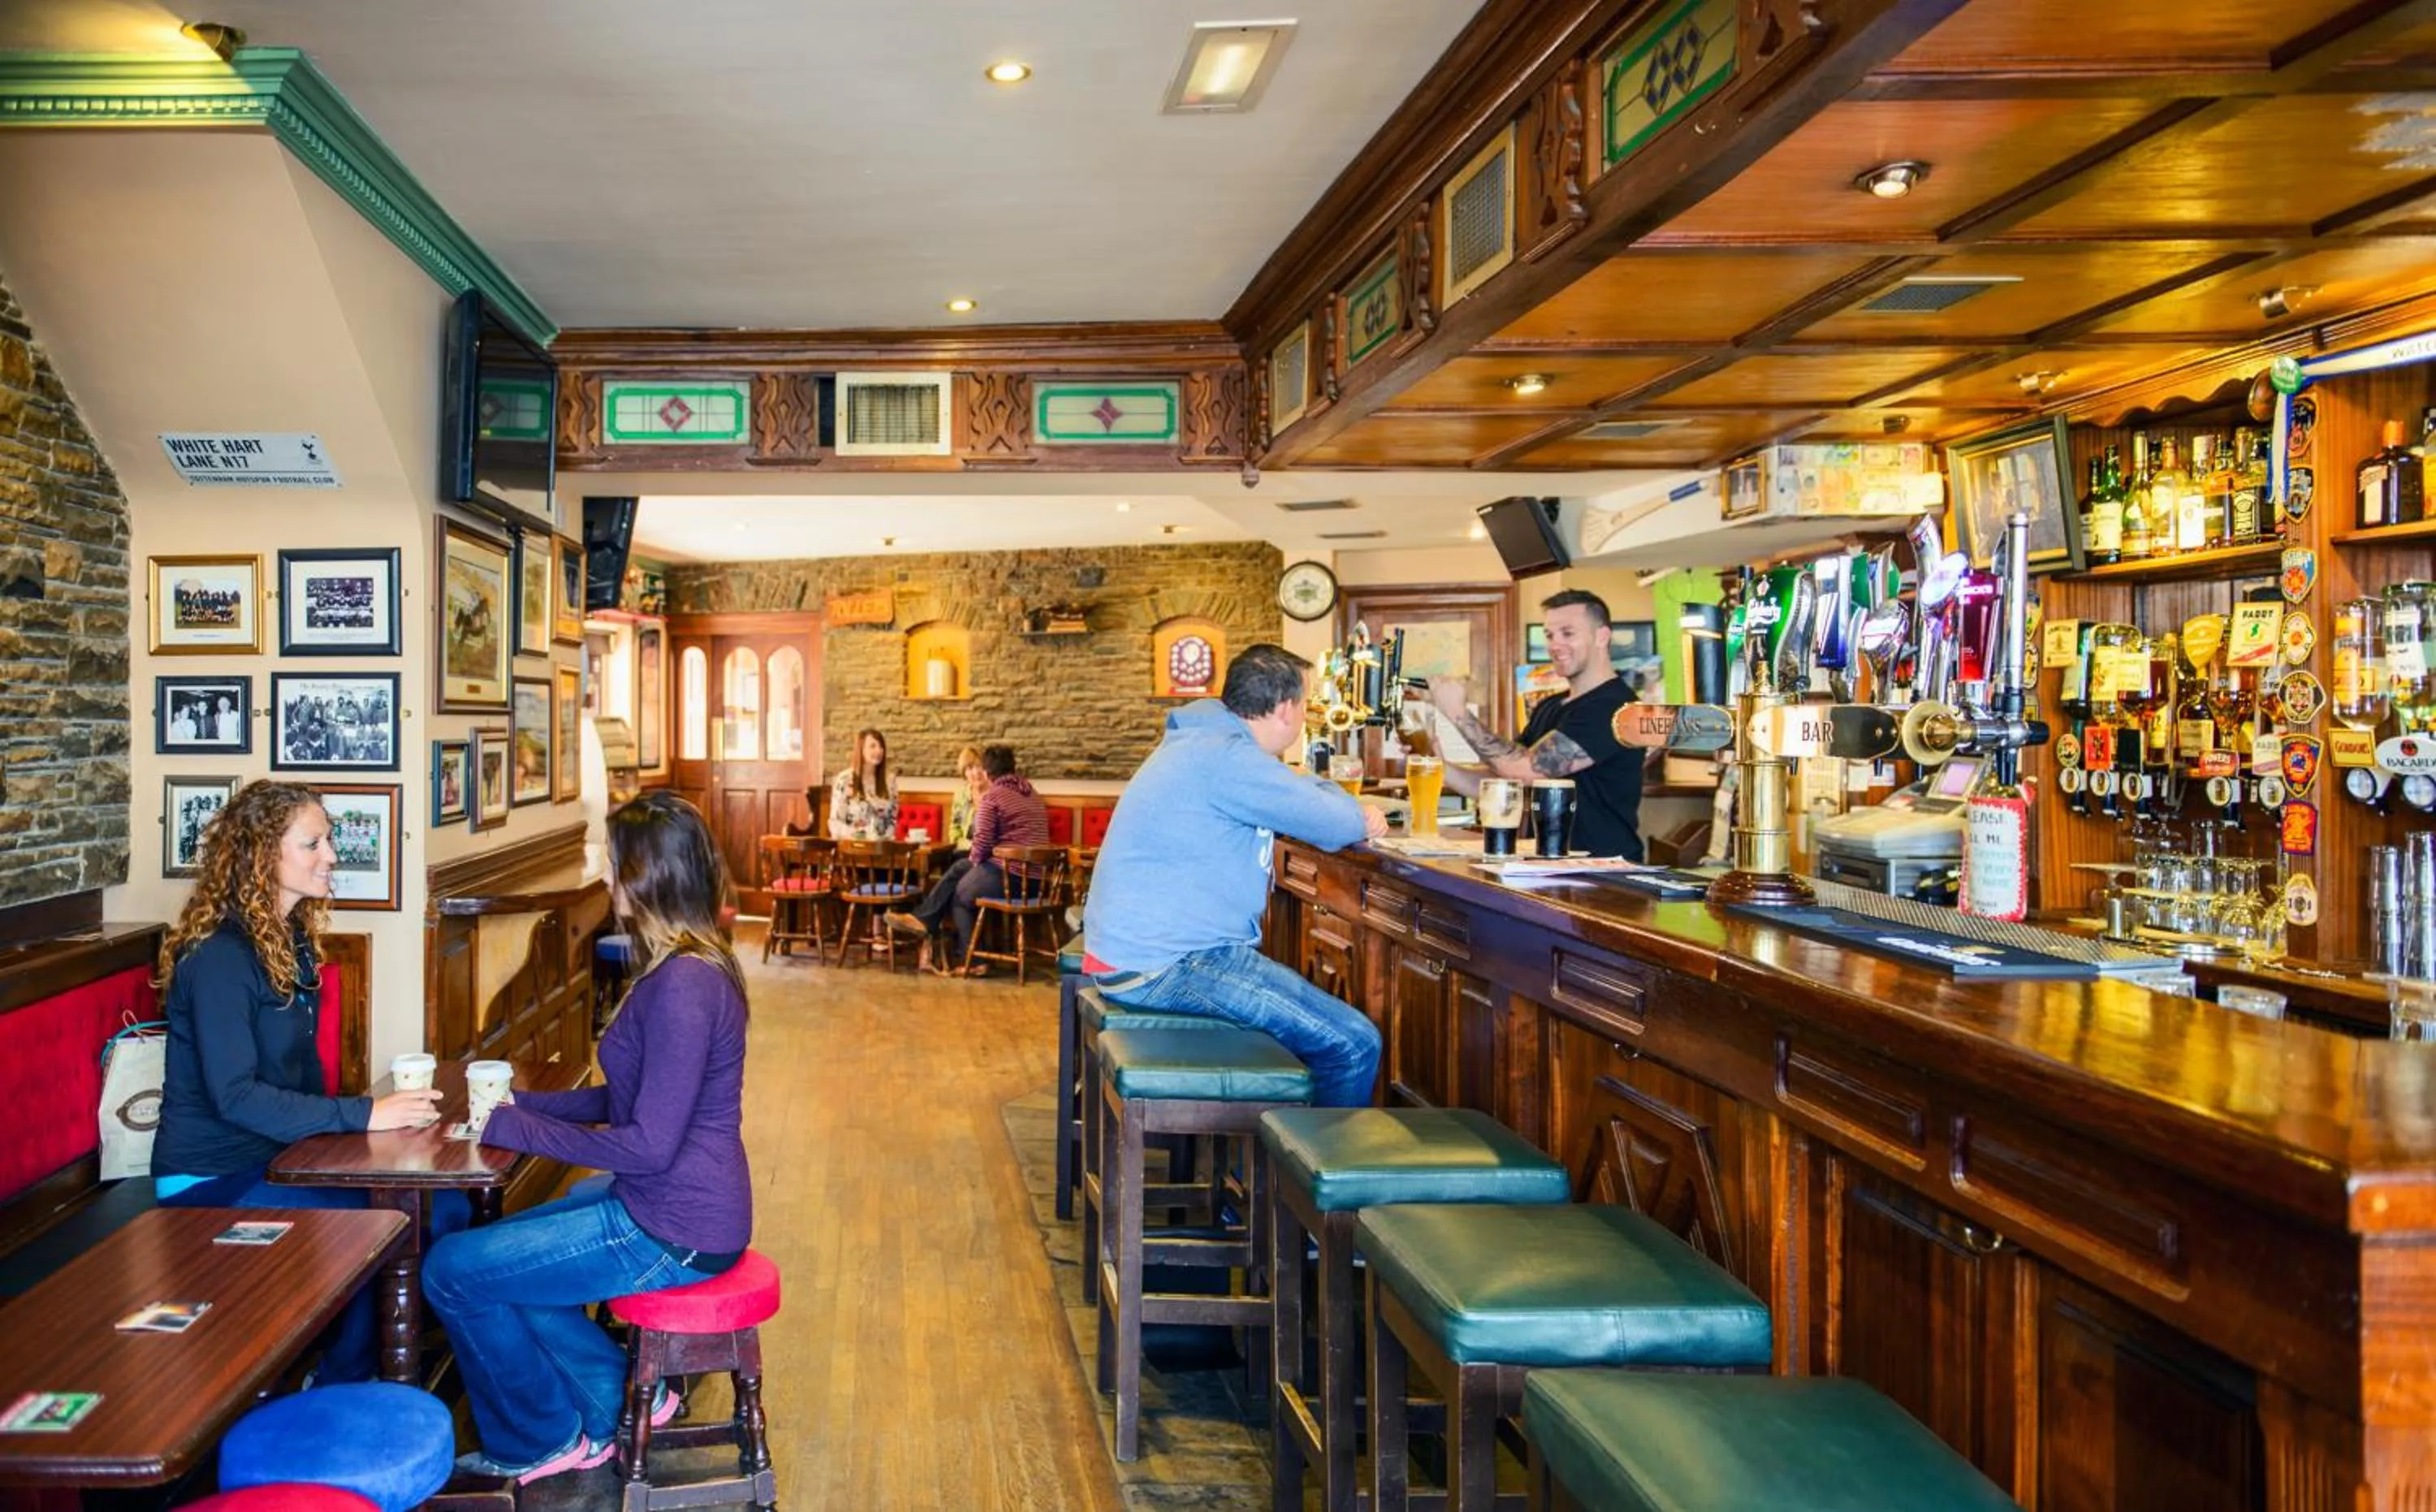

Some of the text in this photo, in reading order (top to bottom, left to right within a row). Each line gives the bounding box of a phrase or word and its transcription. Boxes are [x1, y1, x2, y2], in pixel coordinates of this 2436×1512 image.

[166, 439, 264, 454] WHITE HART
[176, 455, 249, 469] LANE N17
[313, 475, 335, 485] CLUB
[1801, 720, 1833, 741] BAR
